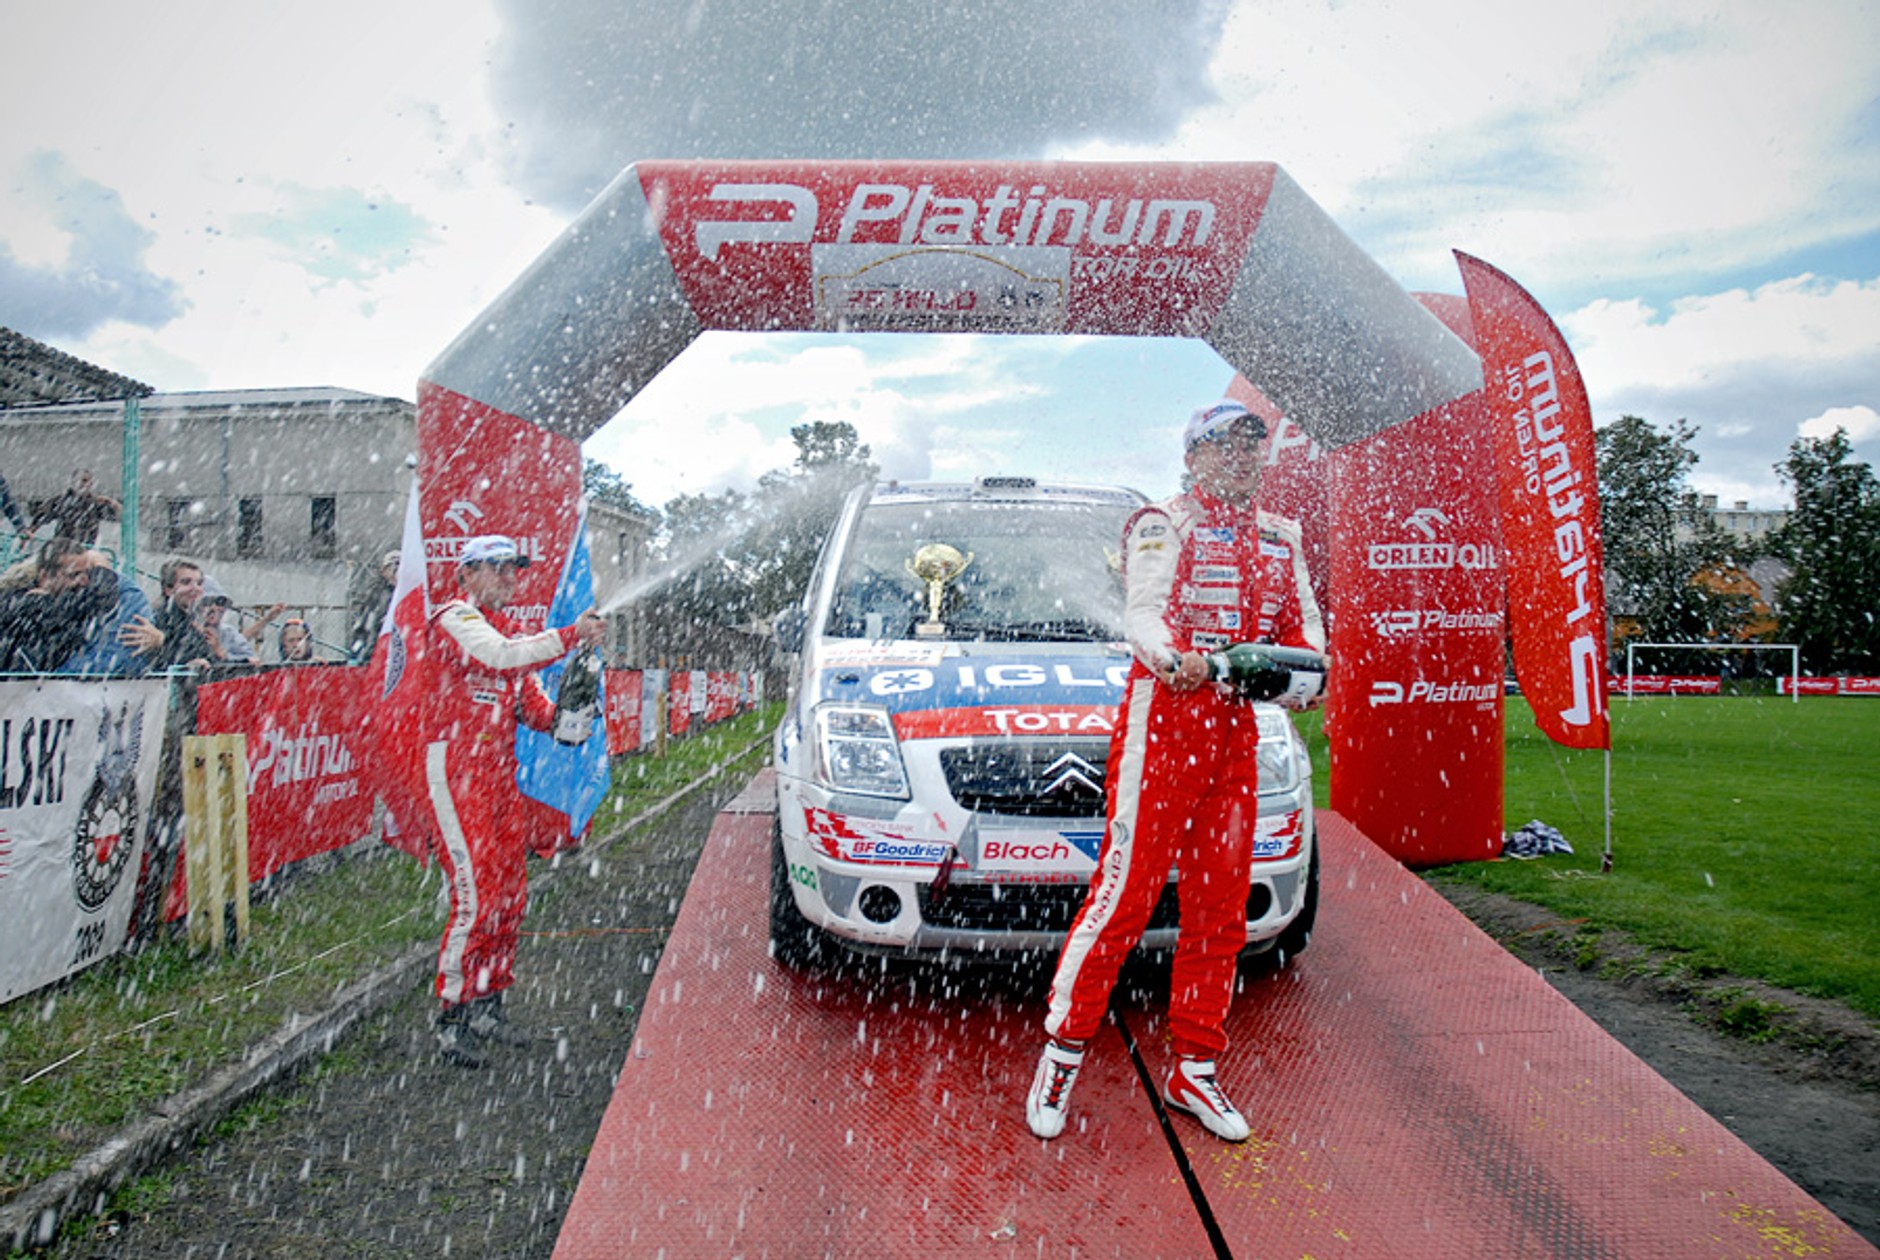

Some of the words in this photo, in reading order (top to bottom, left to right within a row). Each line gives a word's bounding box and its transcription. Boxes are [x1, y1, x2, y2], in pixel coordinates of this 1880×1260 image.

[836, 183, 1216, 247] Platinum
[1072, 256, 1139, 280] TOR
[1373, 547, 1450, 565] ORLEN
[1457, 543, 1499, 570] OIL
[983, 710, 1119, 732] TOTA
[983, 842, 1070, 860] Blach
